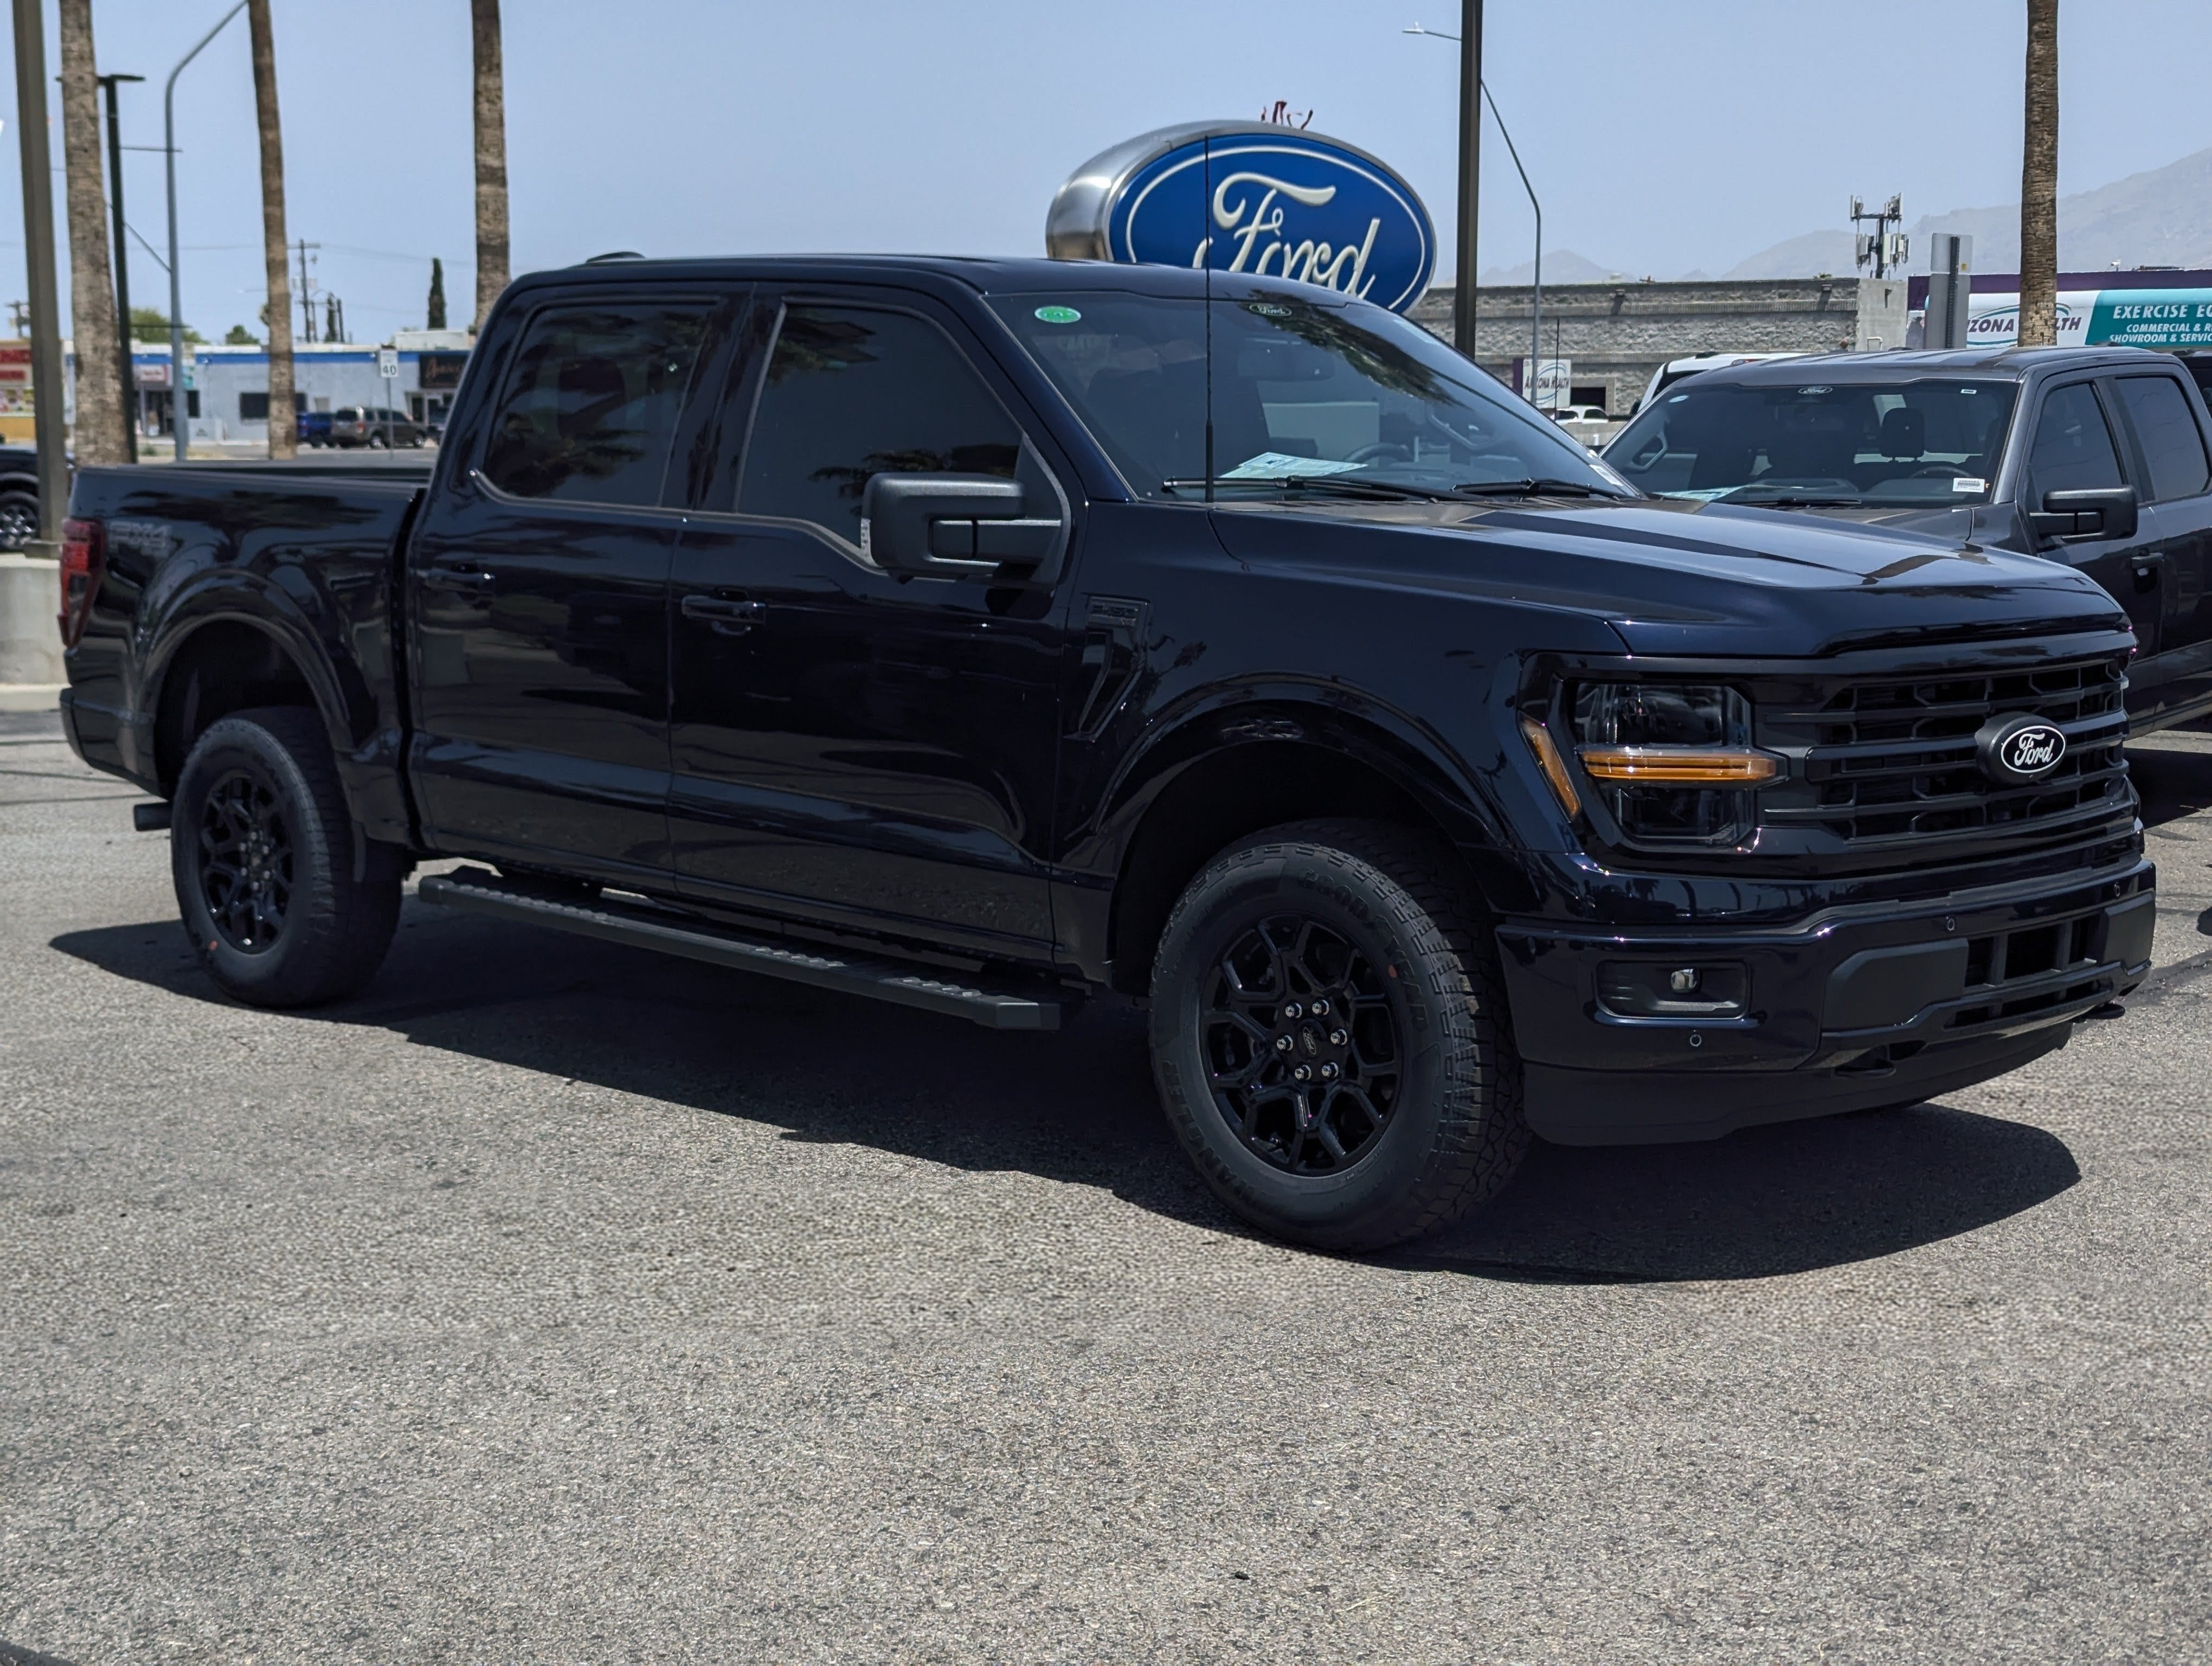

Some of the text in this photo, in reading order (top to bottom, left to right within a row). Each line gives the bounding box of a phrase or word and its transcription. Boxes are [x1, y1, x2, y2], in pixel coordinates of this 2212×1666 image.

[1192, 171, 1380, 299] Ford
[2113, 304, 2189, 319] EXERCISE
[2126, 323, 2191, 332] COMMERCIAL
[2193, 323, 2201, 332] &
[2110, 334, 2168, 343] SHOWROOM
[2169, 334, 2177, 342] &
[383, 364, 397, 375] 40
[2014, 732, 2055, 767] Ford
